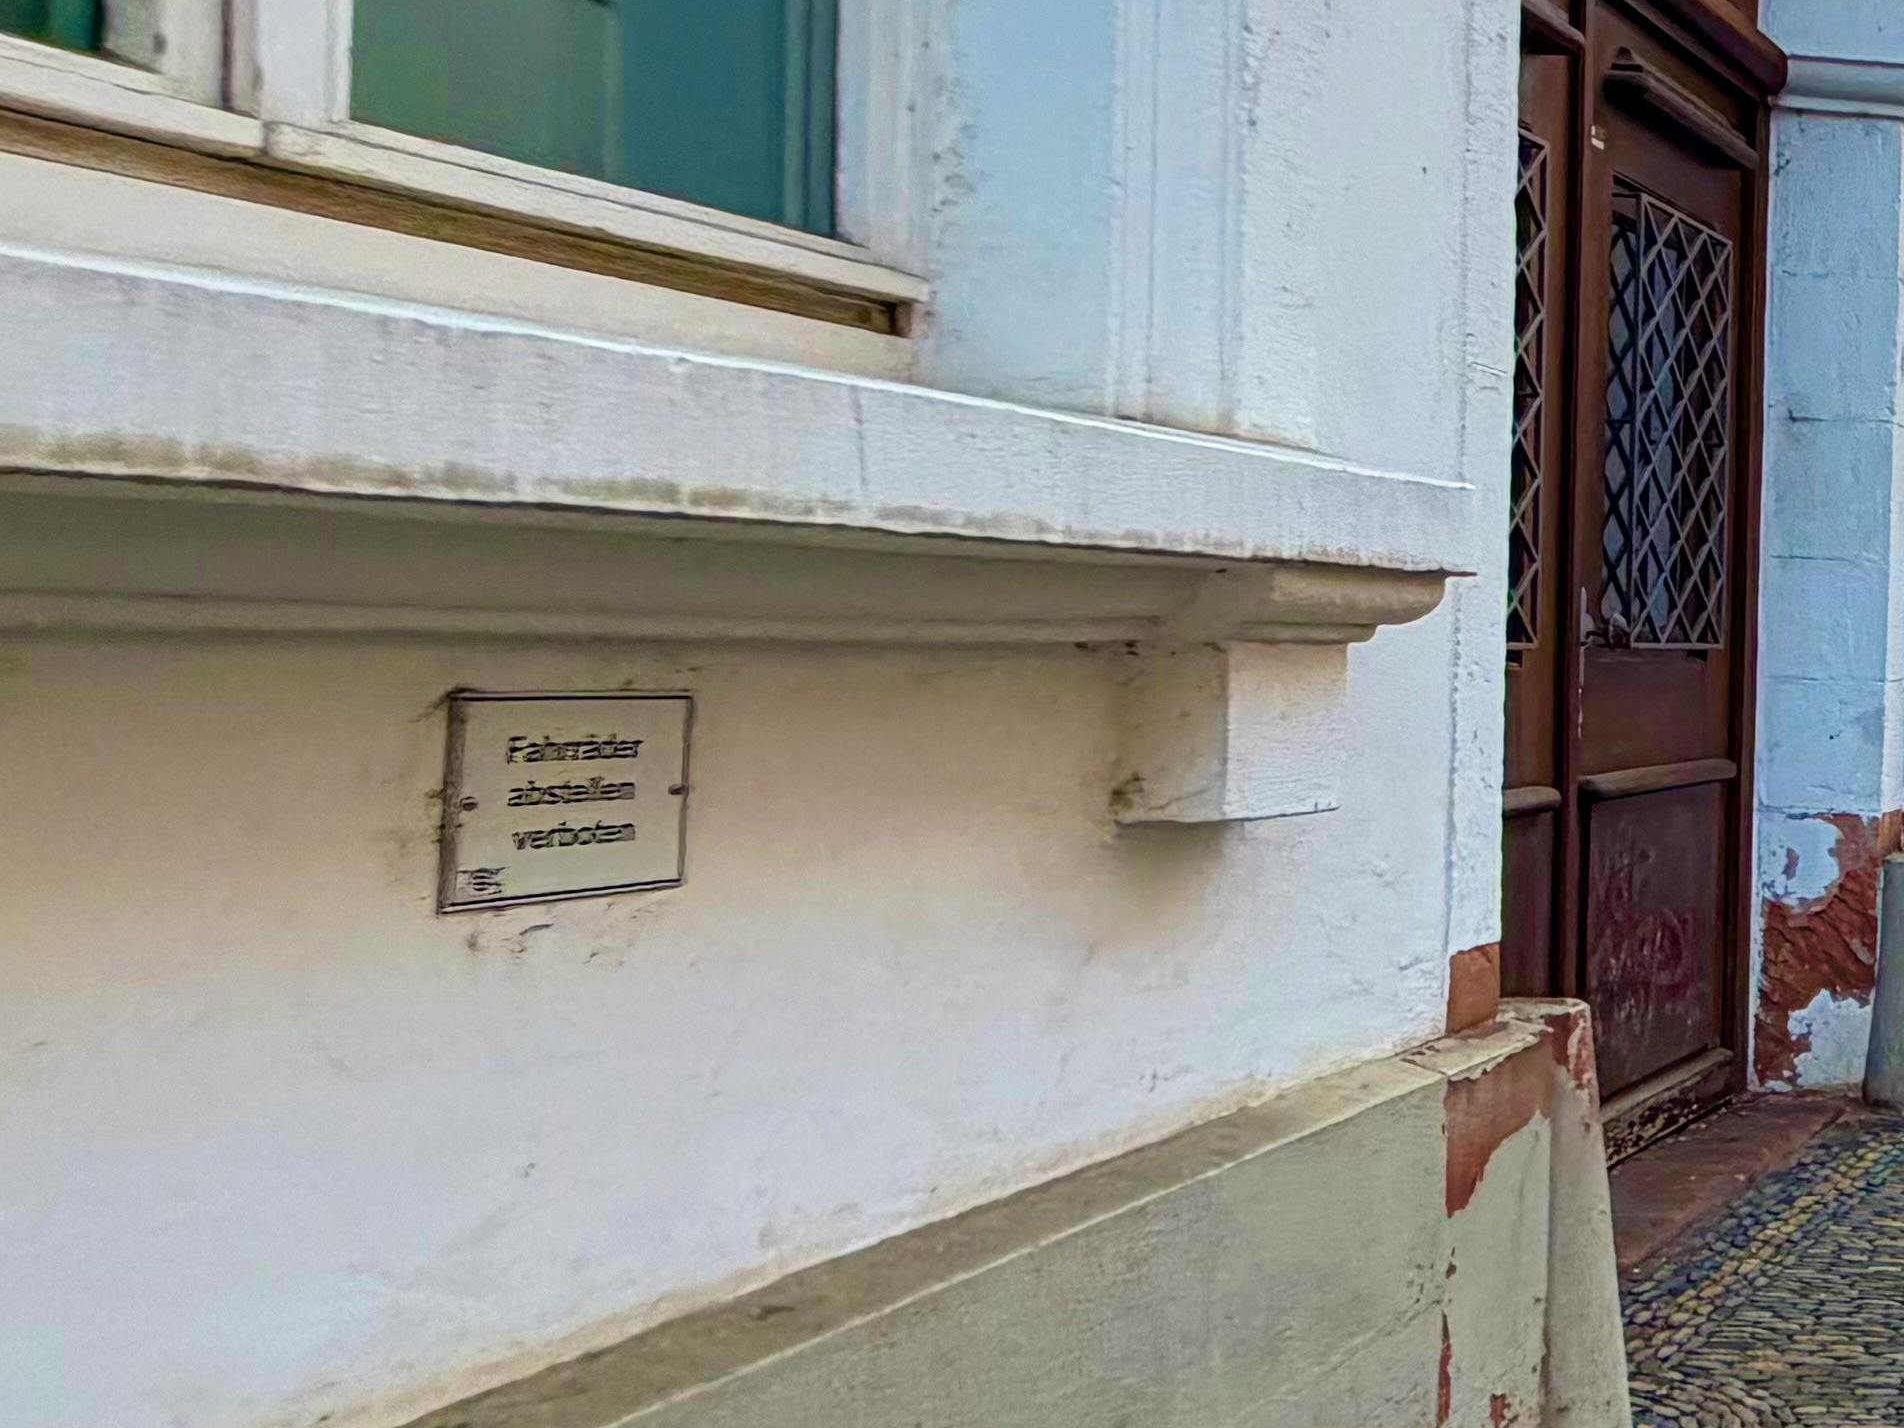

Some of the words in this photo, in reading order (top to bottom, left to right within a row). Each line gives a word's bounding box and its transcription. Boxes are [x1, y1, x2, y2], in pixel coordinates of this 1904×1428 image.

[506, 733, 645, 764] Fahrräder
[506, 775, 636, 807] abstellen
[511, 820, 636, 850] verboten
